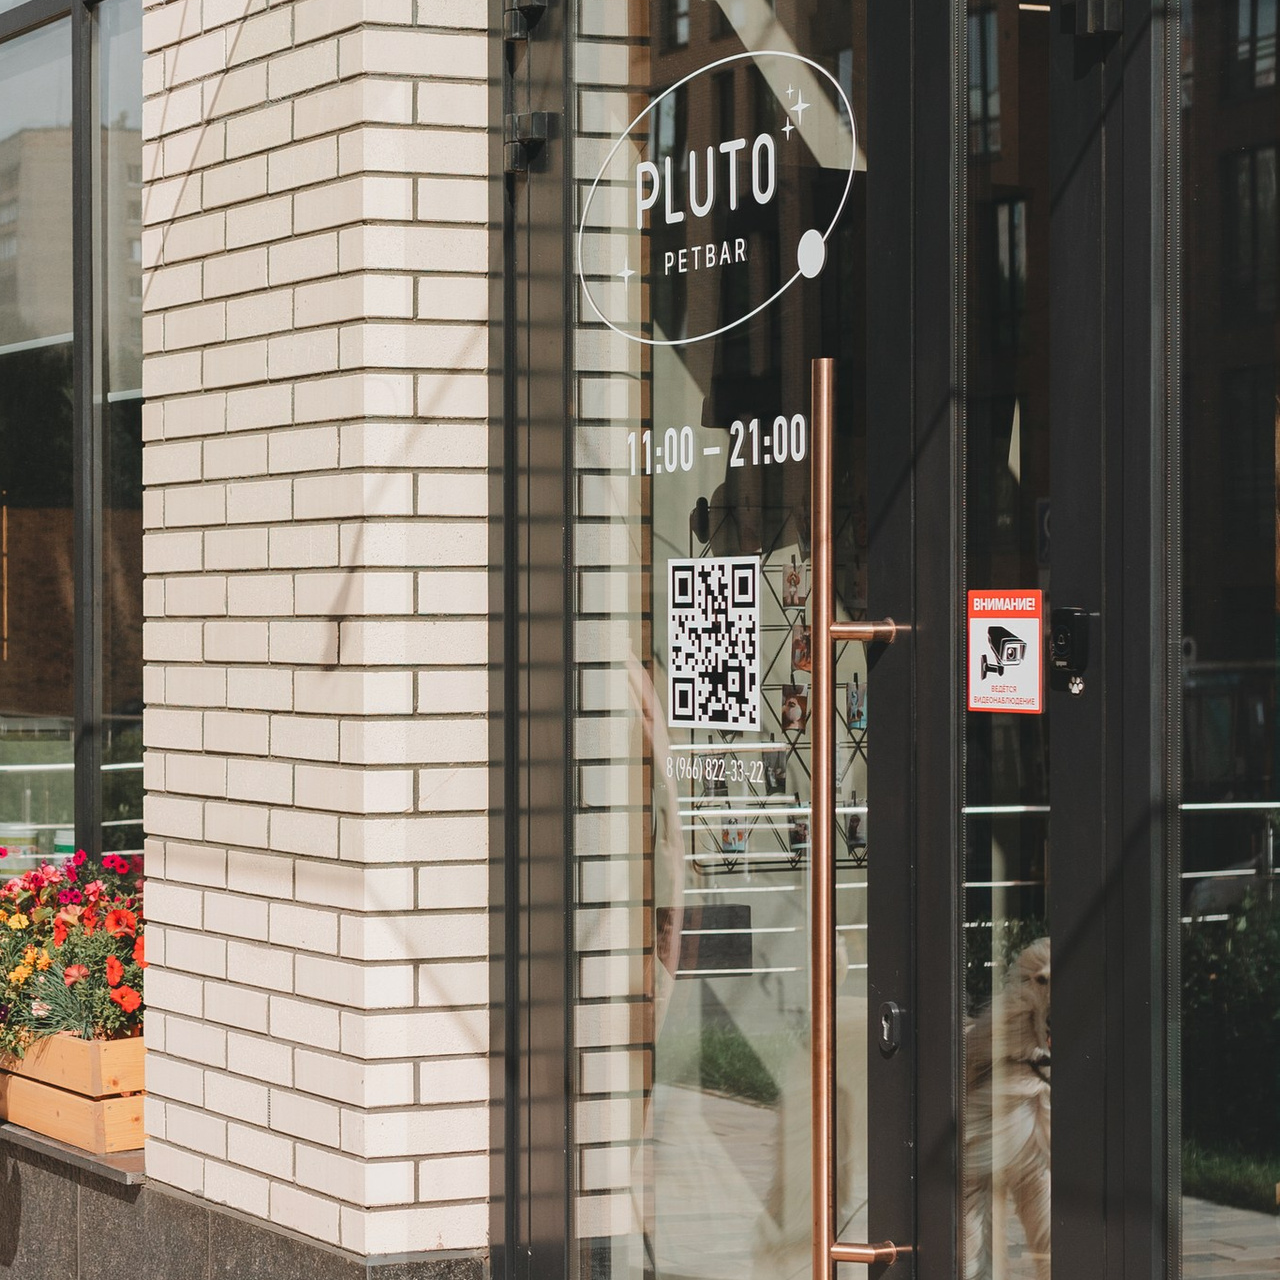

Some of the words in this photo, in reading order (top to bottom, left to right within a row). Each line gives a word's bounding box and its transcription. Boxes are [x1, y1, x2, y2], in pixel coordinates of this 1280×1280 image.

[636, 132, 776, 230] PLUTO
[664, 237, 746, 276] PETBAR
[627, 425, 694, 476] 11:00
[729, 413, 806, 468] 21:00
[973, 597, 1036, 611] ВНИМАНИЕ!
[973, 695, 1036, 706] ВИДЕОНАБЛЮДЕНИЕ
[991, 684, 1017, 693] ВЕДЁТСЯ
[666, 756, 674, 778] 8
[675, 757, 703, 783] (966)
[705, 758, 764, 783] 822-33-22
